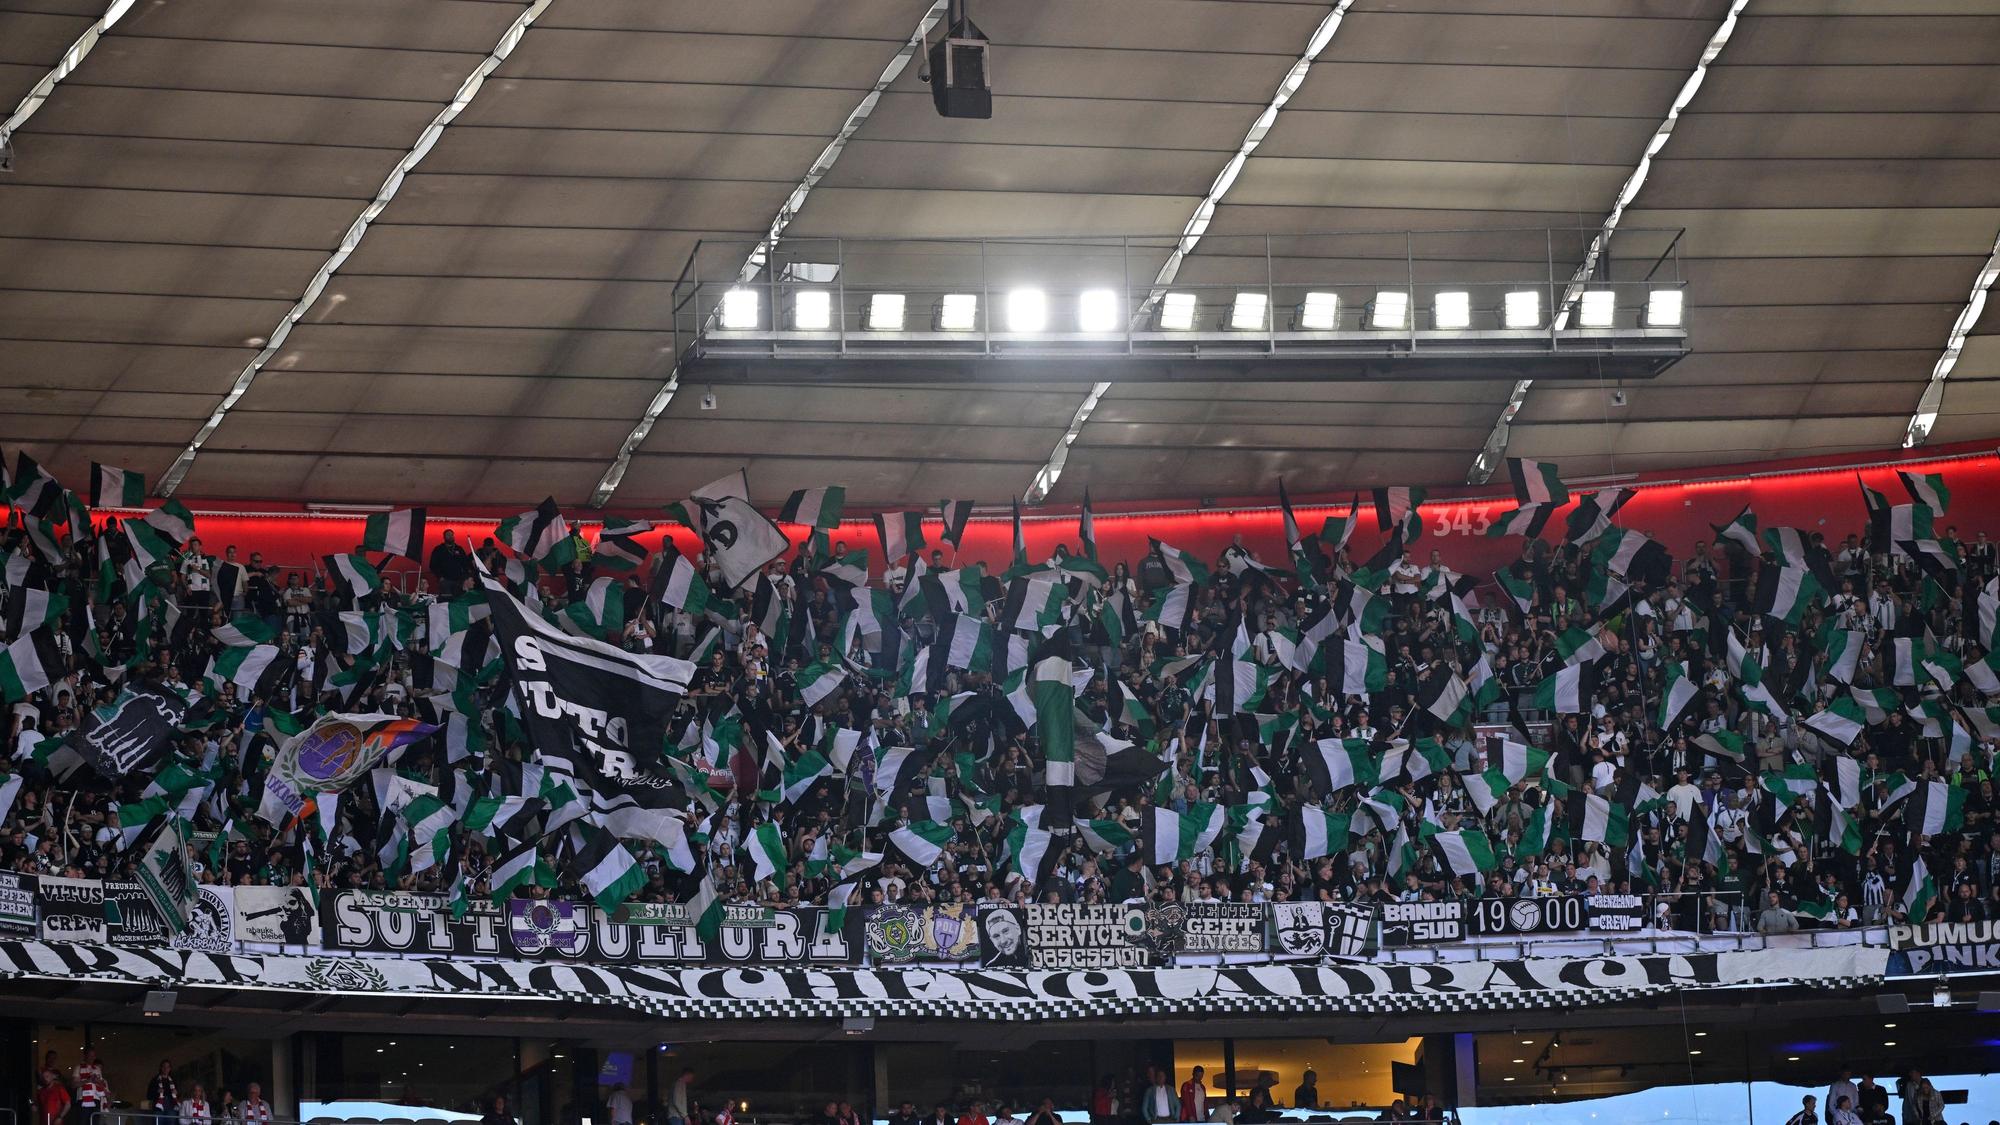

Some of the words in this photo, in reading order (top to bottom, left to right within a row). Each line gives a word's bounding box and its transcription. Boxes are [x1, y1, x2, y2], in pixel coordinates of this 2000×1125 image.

[1433, 507, 1491, 536] 343
[0, 875, 19, 889] EN
[41, 885, 104, 904] VITUS
[358, 892, 500, 913] ASCENDETE
[1594, 894, 1635, 909] GRENZLAND
[1027, 903, 1128, 926] BEGLEIT
[1185, 902, 1263, 921] HEUTE
[1383, 902, 1461, 922] BANDA
[1474, 900, 1505, 932] 19
[1545, 898, 1580, 930] 00
[46, 914, 103, 932] CREW
[246, 927, 273, 935] rabauke
[1186, 918, 1256, 935] GEHT
[1413, 921, 1459, 940] SUD
[1600, 914, 1630, 931] CREW
[174, 933, 232, 951] ACKERBANDE
[1027, 924, 1126, 948] SERVICE
[1185, 933, 1262, 952] EINIGES
[1031, 947, 1149, 968] OBSESSION
